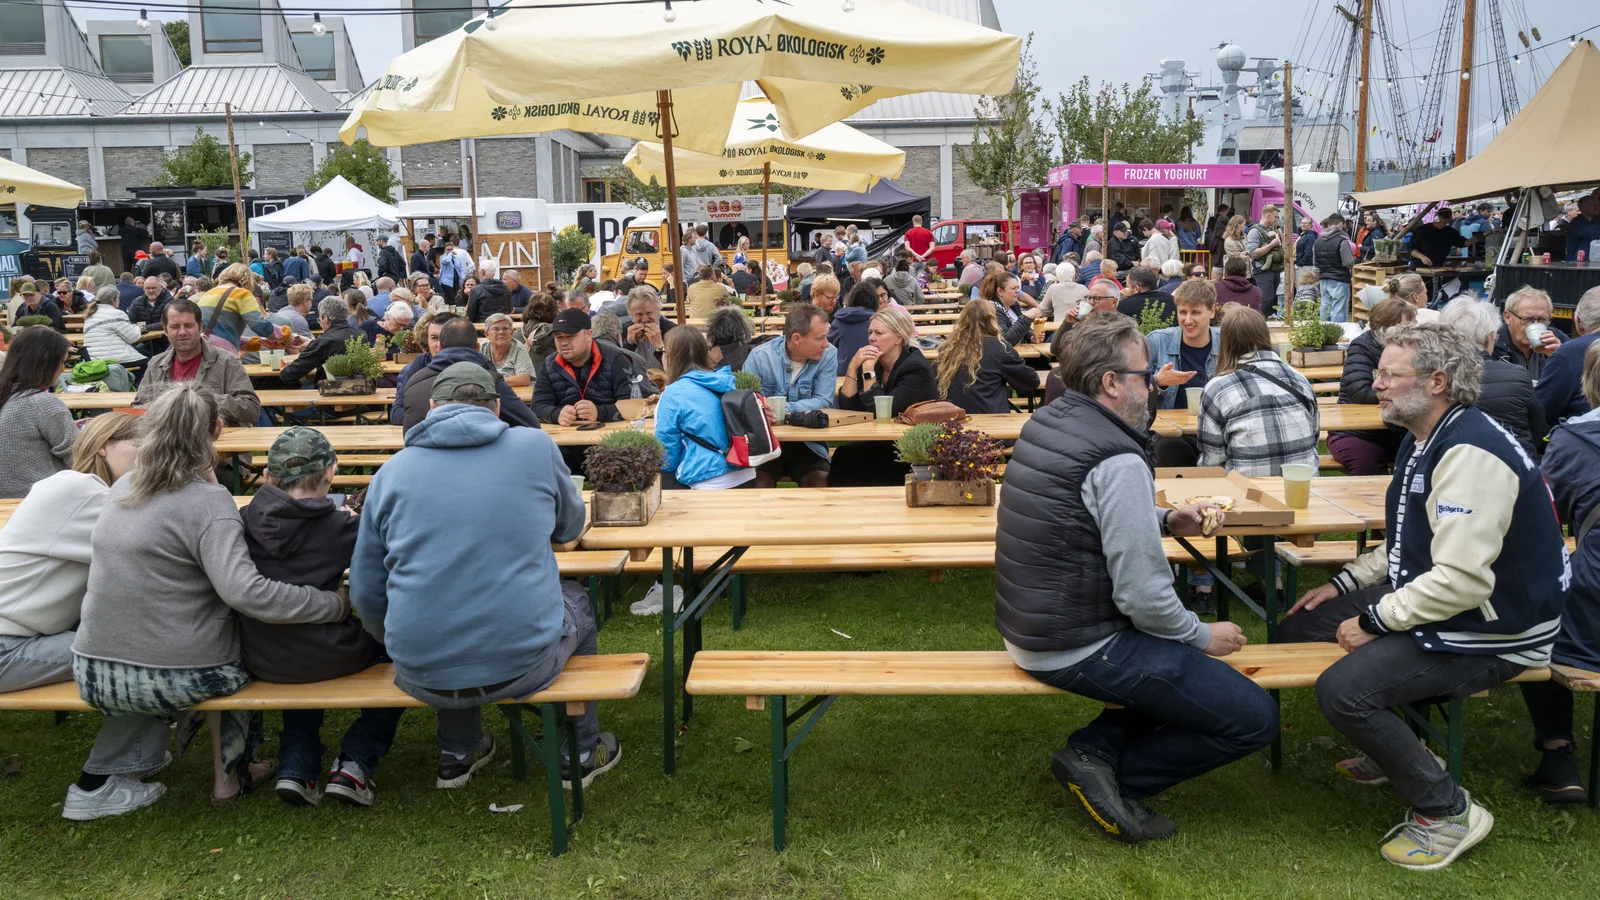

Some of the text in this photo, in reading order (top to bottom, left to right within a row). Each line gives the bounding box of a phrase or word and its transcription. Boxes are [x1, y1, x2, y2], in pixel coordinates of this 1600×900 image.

[717, 34, 848, 60] ROYAL ØKOLOGISK
[738, 145, 806, 158] ROYAL ØKOLOGISK
[1124, 168, 1208, 180] FROZEN YOGHURT
[1294, 190, 1317, 210] BARONS
[483, 242, 536, 266] VIN
[0, 255, 15, 272] AD
